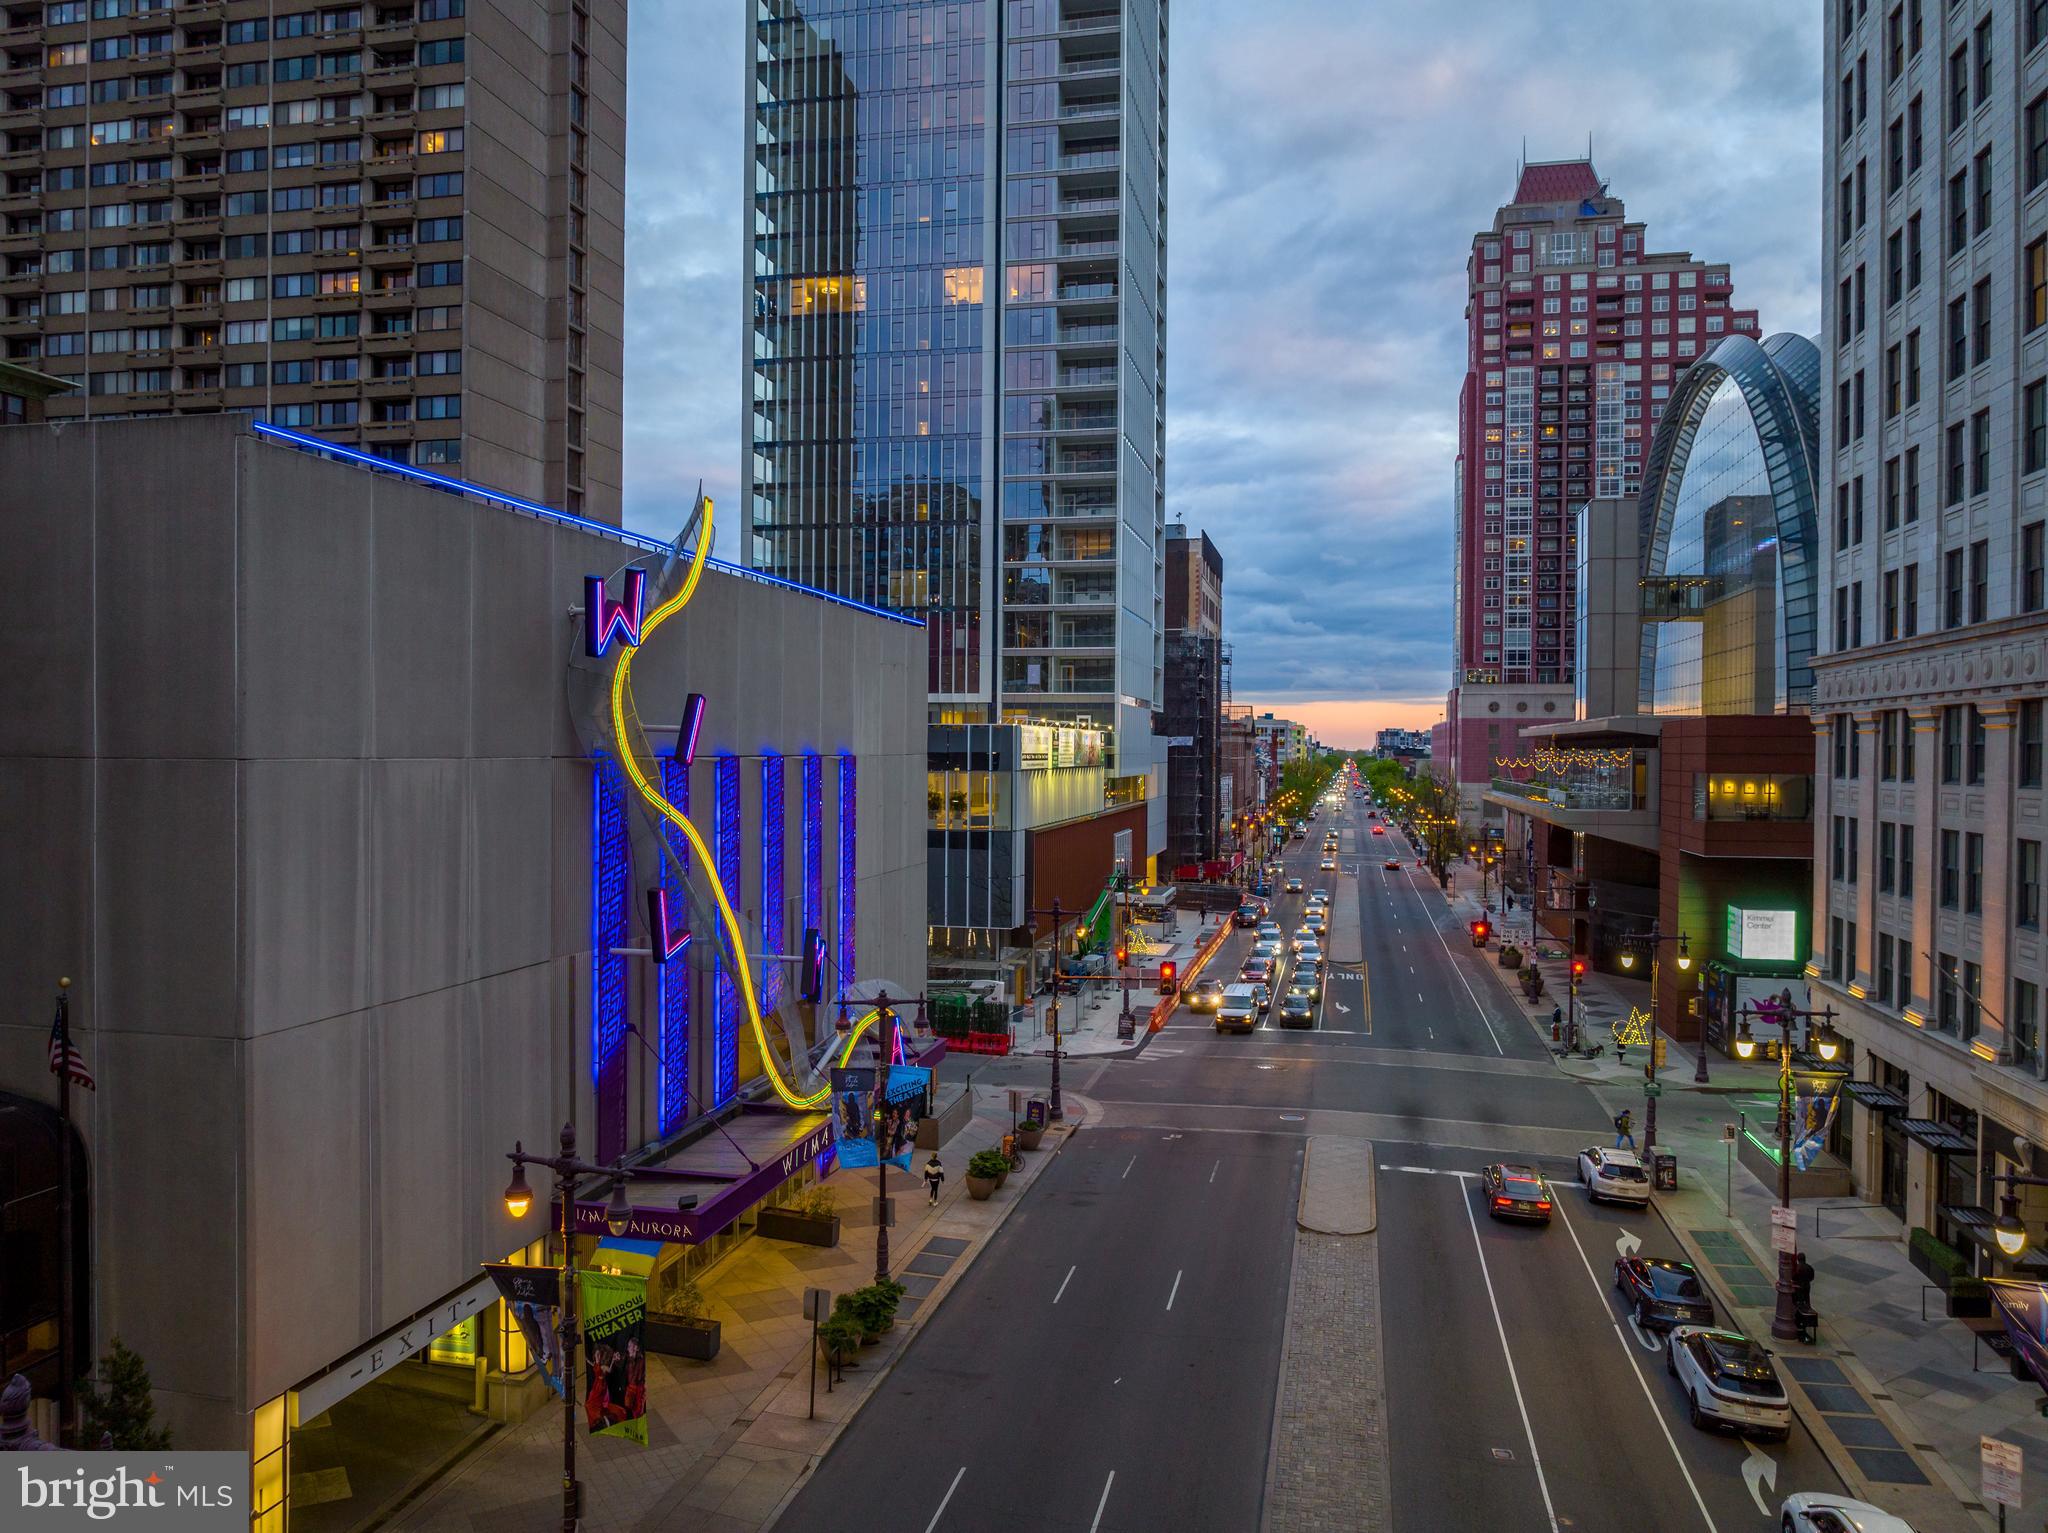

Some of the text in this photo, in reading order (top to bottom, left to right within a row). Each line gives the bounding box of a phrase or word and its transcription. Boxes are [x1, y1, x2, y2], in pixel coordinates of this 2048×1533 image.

[1746, 921, 1772, 929] Center
[886, 1078, 922, 1097] EXCITING
[888, 1086, 924, 1105] THEATER
[782, 1126, 829, 1176] WILMA
[575, 1207, 693, 1238] ILM AURORA
[588, 1309, 644, 1342] THEATER
